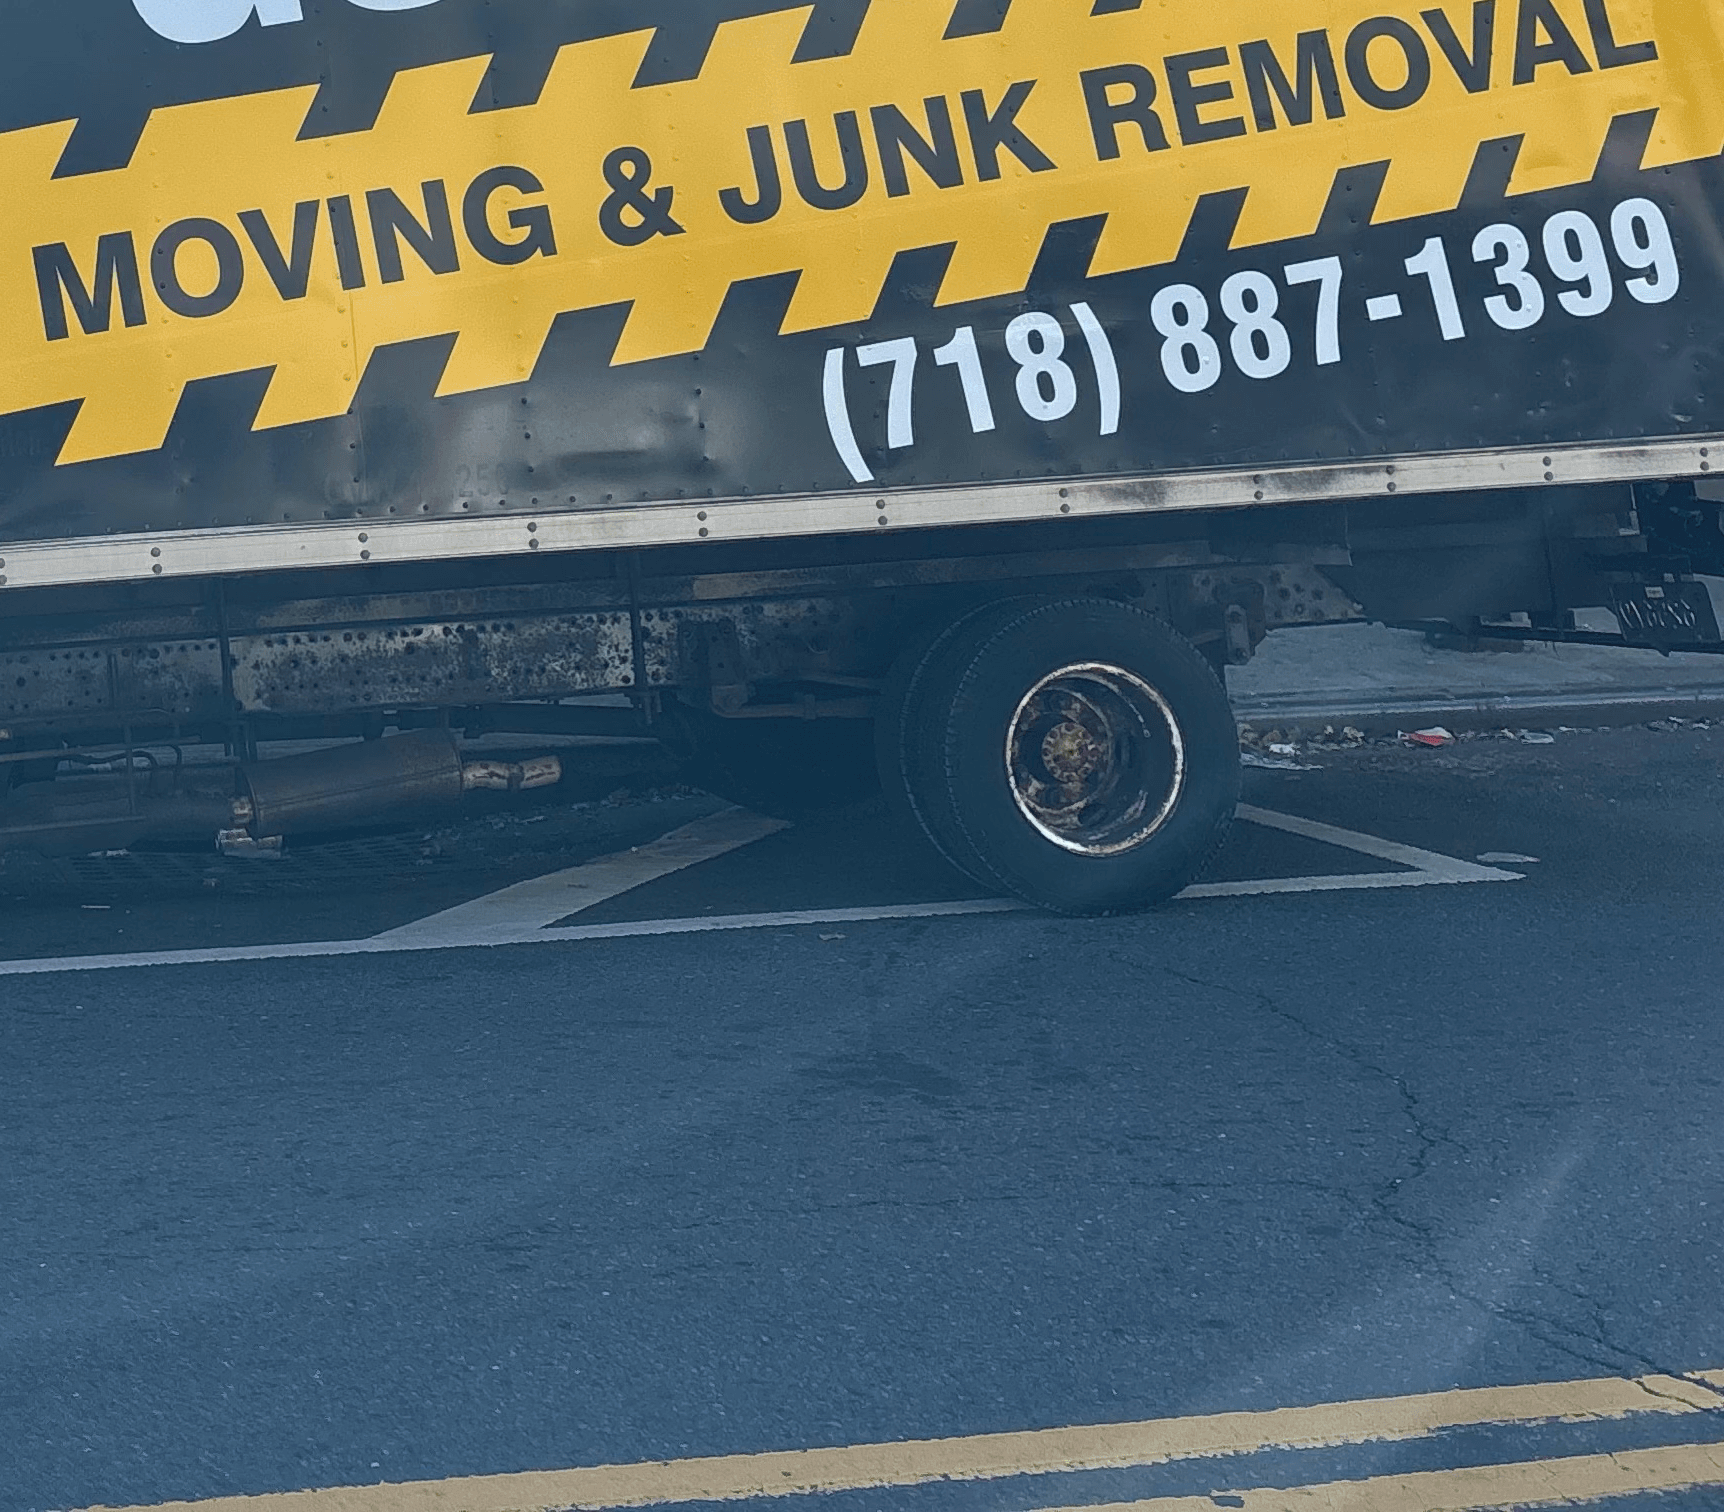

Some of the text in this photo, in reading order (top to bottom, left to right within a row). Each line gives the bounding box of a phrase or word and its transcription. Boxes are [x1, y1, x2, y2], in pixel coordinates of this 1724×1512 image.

[31, 166, 551, 341] MOVING
[600, 146, 683, 244] &
[717, 80, 1053, 226] JUNK
[823, 196, 1682, 484] (718) 887-1399
